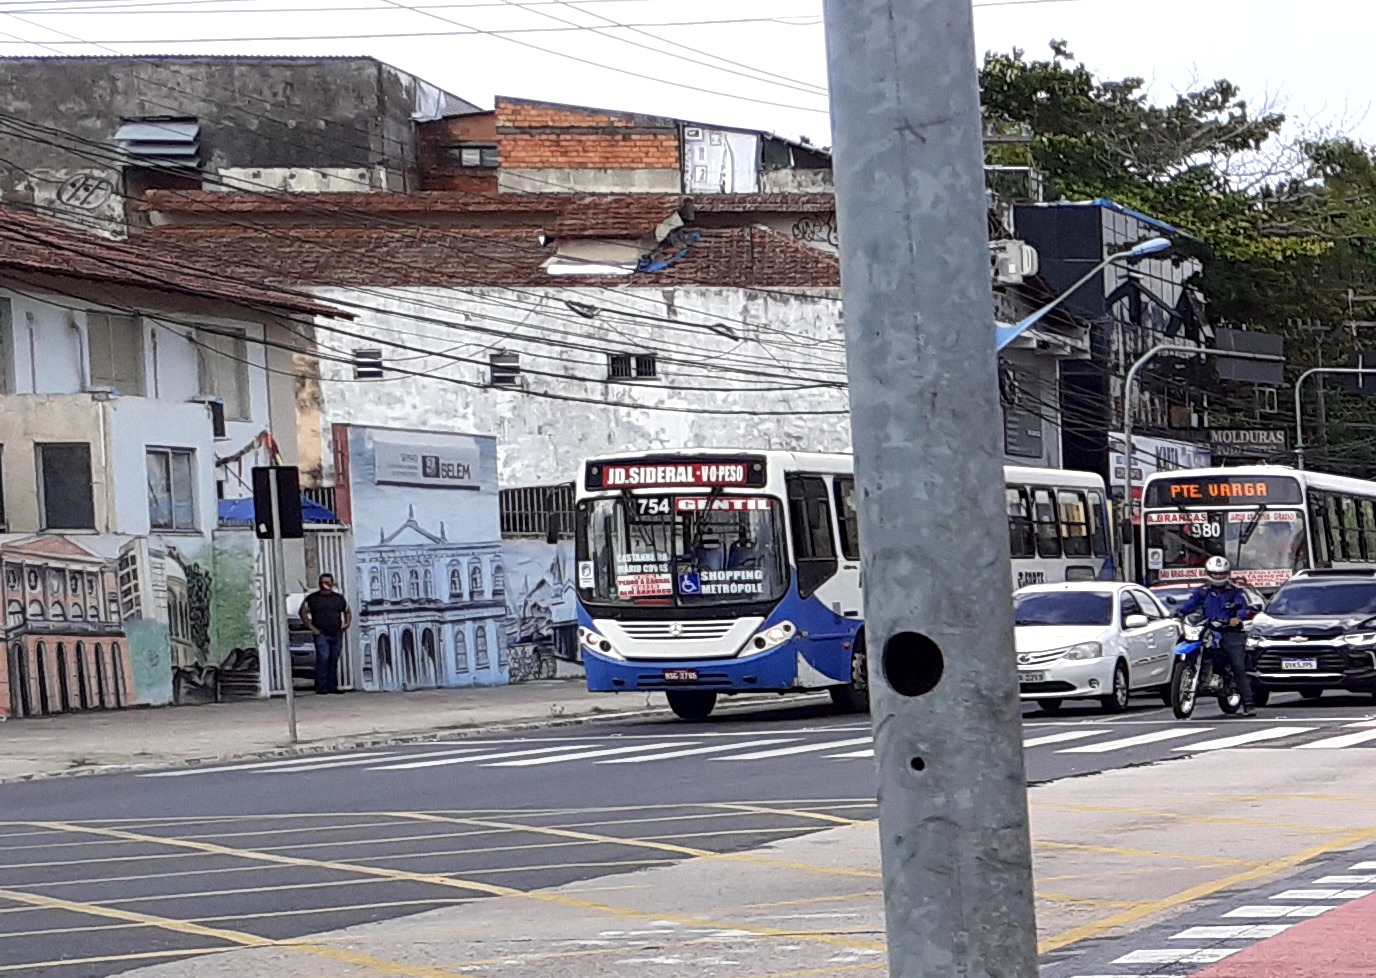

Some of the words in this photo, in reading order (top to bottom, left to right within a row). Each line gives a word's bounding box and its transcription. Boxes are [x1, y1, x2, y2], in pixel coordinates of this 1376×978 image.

[1210, 429, 1285, 444] MOLDURAS
[1208, 482, 1268, 497] VARGA
[638, 498, 670, 515] 754
[677, 499, 771, 510] GENTIL
[1191, 522, 1221, 538] 980
[700, 570, 763, 581] SHOPPING
[701, 582, 763, 595] METRÓPOLE
